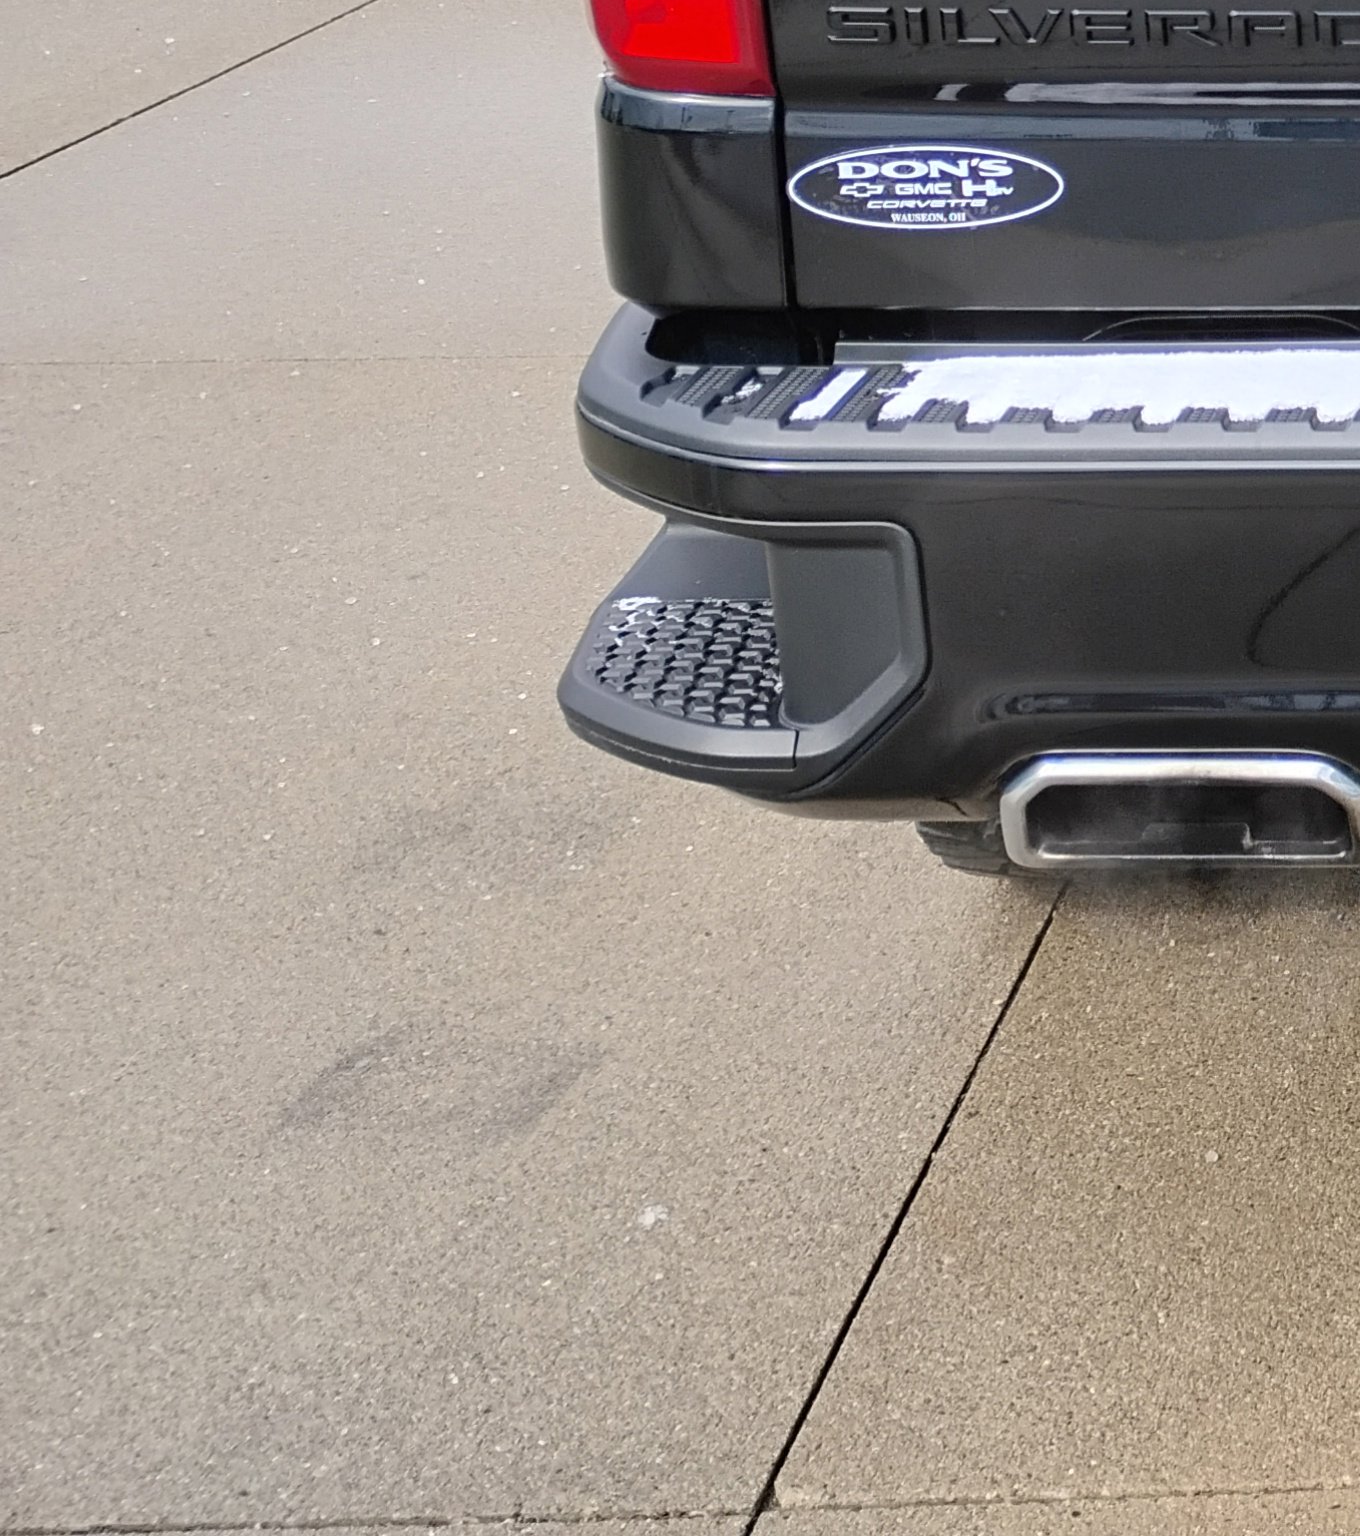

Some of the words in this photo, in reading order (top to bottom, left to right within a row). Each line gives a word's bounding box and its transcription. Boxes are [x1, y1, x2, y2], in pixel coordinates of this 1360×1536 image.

[838, 159, 1013, 179] DON'S
[895, 183, 952, 195] GMC
[867, 199, 988, 209] CORVETTE
[891, 214, 948, 223] WAUSEON,
[950, 213, 966, 222] OH
